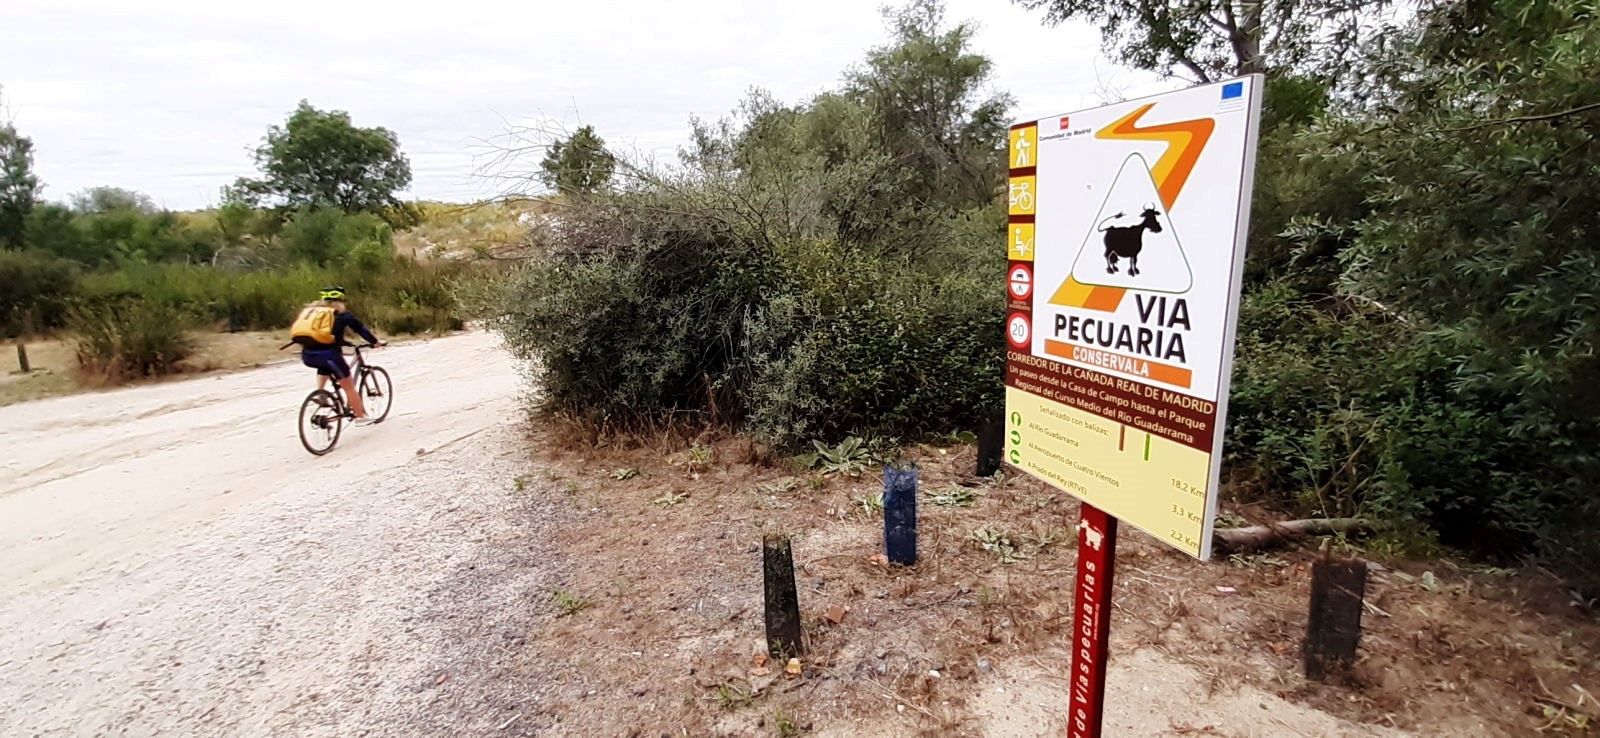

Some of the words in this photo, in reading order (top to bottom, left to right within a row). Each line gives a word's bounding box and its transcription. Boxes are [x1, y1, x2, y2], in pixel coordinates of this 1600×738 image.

[1039, 132, 1065, 141] Comunidad
[1073, 127, 1092, 136] Madrid
[1135, 293, 1191, 331] VIA
[1012, 323, 1025, 337] 20
[1055, 313, 1186, 363] PECUARIA
[1072, 346, 1149, 377] CONSERVALA
[1007, 351, 1048, 370] CORREDOR
[1049, 362, 1060, 373] DE
[1061, 365, 1072, 376] LA
[1074, 368, 1114, 388] CAÑADA
[1116, 379, 1142, 396] REAL
[1144, 386, 1160, 400] DE
[1162, 391, 1213, 415] MADRID
[1009, 365, 1019, 374] Un
[1019, 369, 1038, 380] paseo
[1039, 373, 1060, 386] desde
[1060, 379, 1067, 389] la
[1068, 382, 1086, 394] Casa
[1087, 387, 1098, 398] de
[1099, 390, 1129, 407] Campo
[1131, 399, 1156, 415] hasta
[1157, 408, 1167, 419] el
[1169, 411, 1206, 431] Parque
[1015, 378, 1042, 394] Regional
[1043, 387, 1054, 397] del
[1054, 391, 1076, 405] Curso
[1076, 398, 1101, 413] Medio
[1102, 406, 1116, 418] del
[1133, 416, 1194, 444] Guadarrama
[1071, 417, 1083, 427] con
[1029, 422, 1035, 430] Al
[1044, 427, 1079, 448] Guadarrama
[1028, 441, 1034, 449] Al
[1034, 444, 1065, 463] Aeropuerto
[1065, 458, 1073, 466] de
[1073, 461, 1094, 476] Cuatro
[1094, 469, 1120, 488] Vientos
[1032, 462, 1047, 475] Prado
[1047, 471, 1056, 480] del
[1056, 474, 1067, 486] Rey
[1190, 486, 1205, 499] Km
[1172, 504, 1184, 516] 3,3
[1187, 511, 1201, 524] Km
[1185, 536, 1199, 549] Km
[1074, 708, 1087, 732] de
